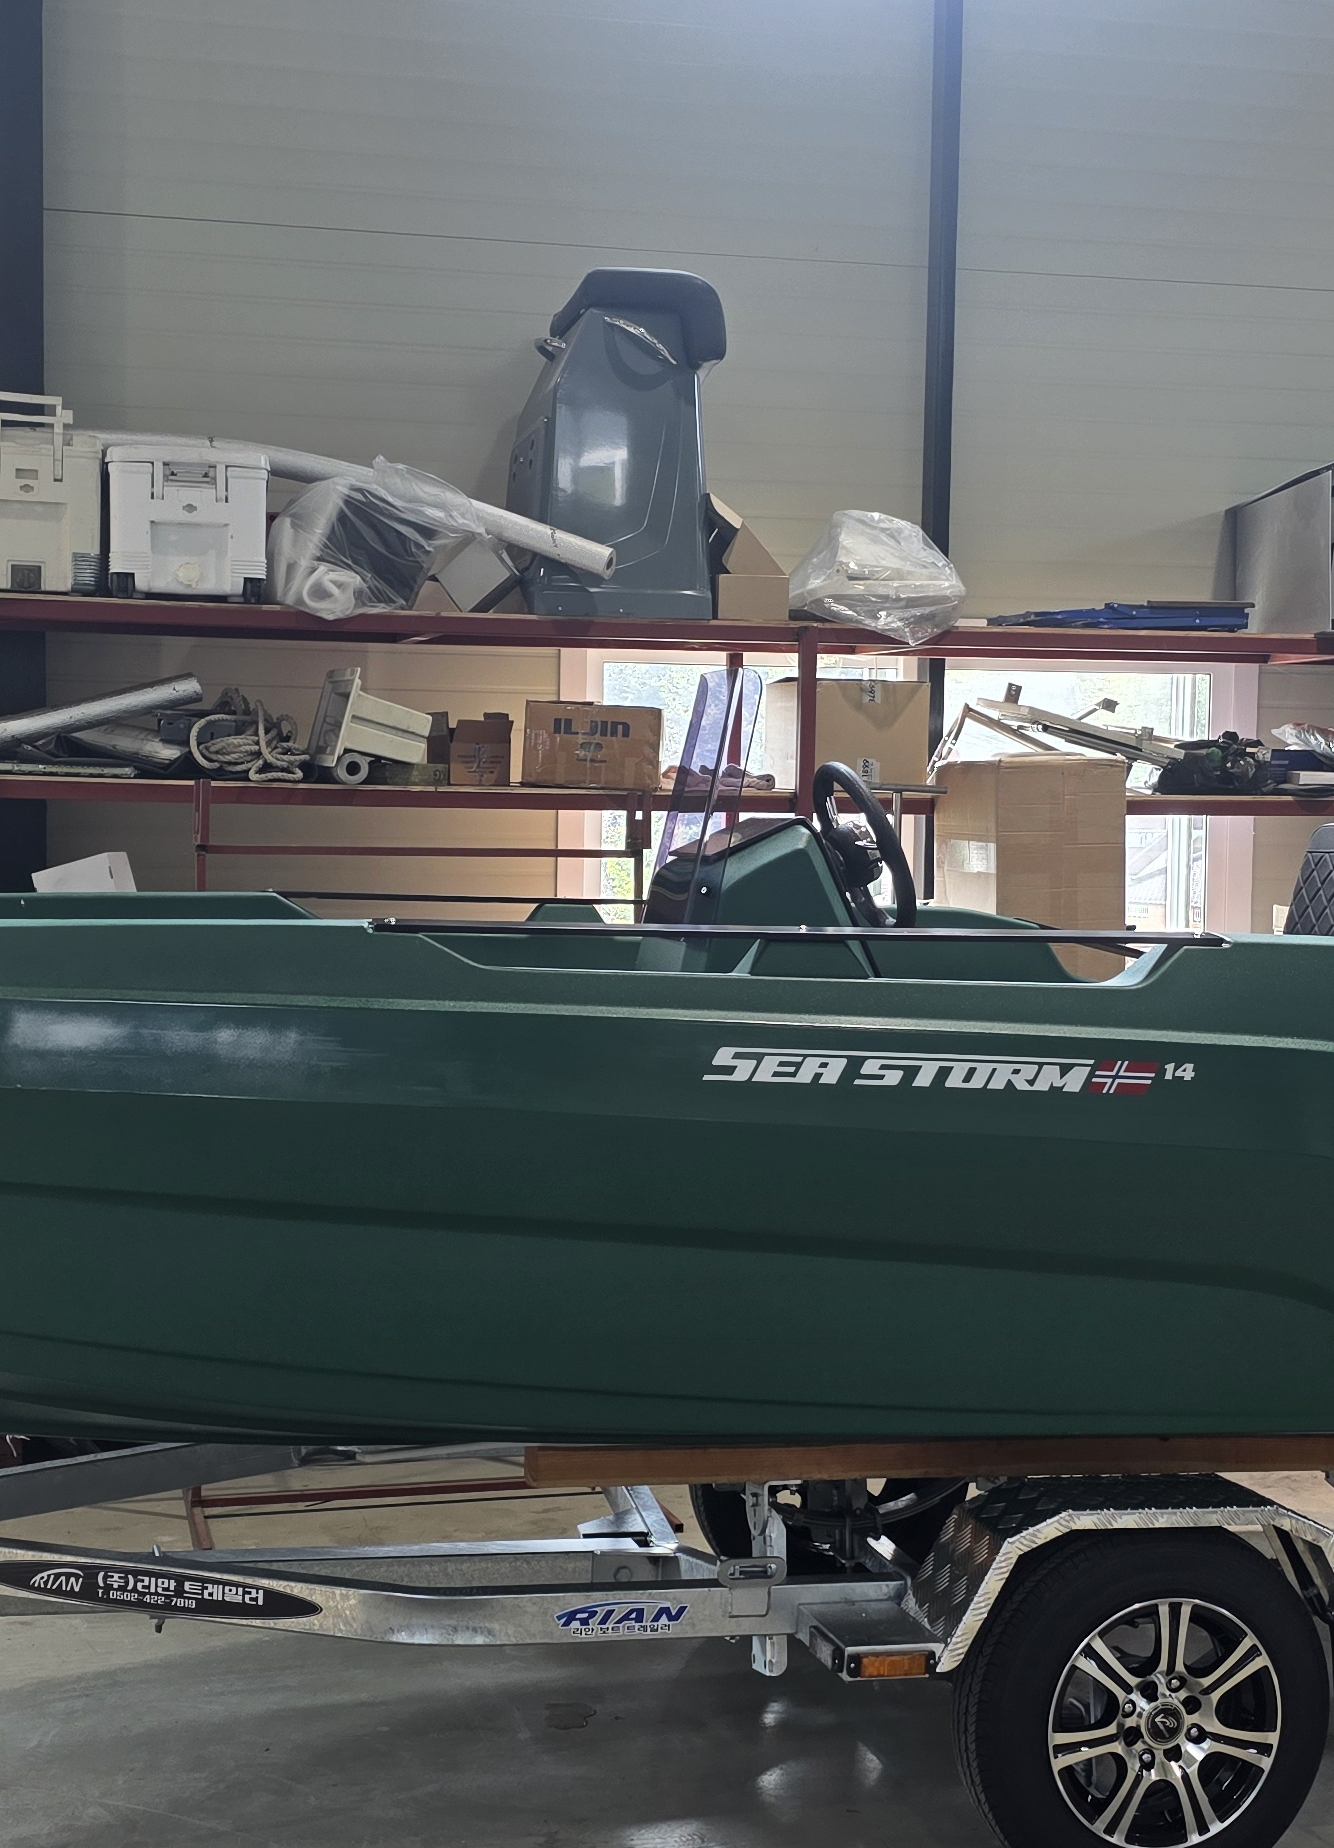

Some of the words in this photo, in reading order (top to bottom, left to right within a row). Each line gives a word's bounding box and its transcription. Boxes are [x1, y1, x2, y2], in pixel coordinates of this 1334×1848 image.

[702, 1046, 848, 1084] SEA
[852, 1058, 1092, 1093] STORM
[1163, 1061, 1196, 1082] 14
[30, 1568, 84, 1592] RIAN
[183, 1581, 264, 1606] 트레일러
[555, 1600, 689, 1628] RIAN
[572, 1626, 595, 1636] 리안
[599, 1625, 622, 1635] 보트
[626, 1623, 671, 1634] 트레일러
